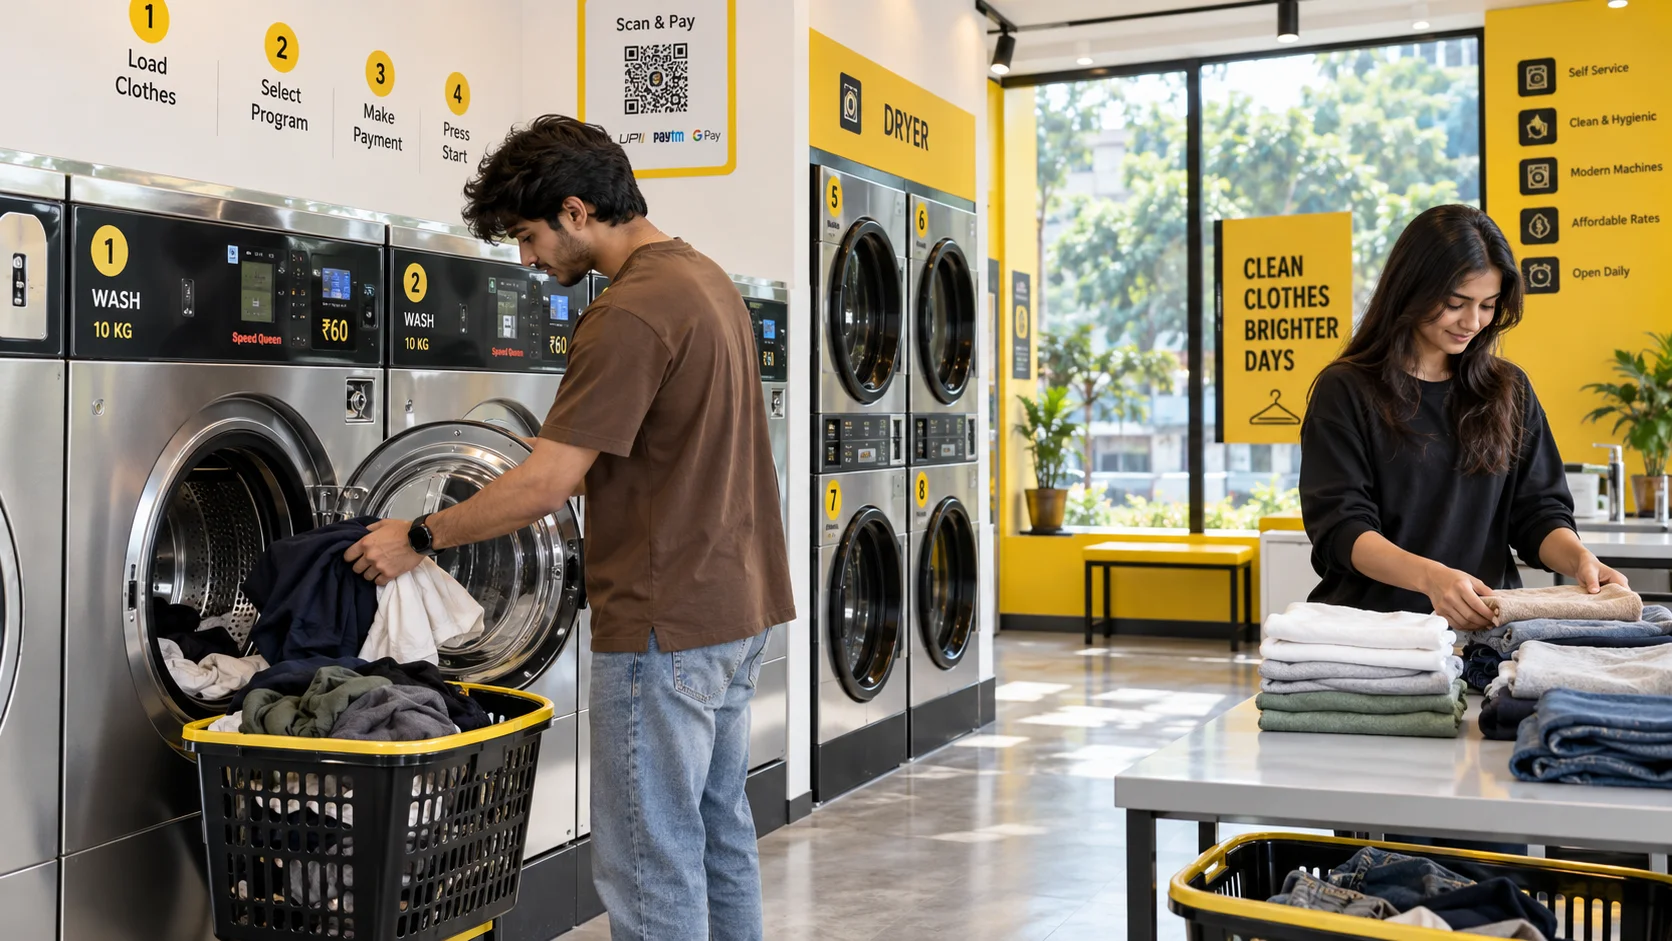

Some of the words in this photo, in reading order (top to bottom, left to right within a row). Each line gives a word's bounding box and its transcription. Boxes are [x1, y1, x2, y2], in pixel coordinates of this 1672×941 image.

[145, 4, 153, 28] 1
[616, 18, 650, 31] Scan
[654, 16, 665, 29] &
[669, 15, 695, 31] Pay
[276, 36, 287, 60] 2
[128, 49, 167, 75] Load
[1569, 65, 1588, 77] Self
[1591, 63, 1629, 76] Service
[376, 63, 385, 84] 3
[115, 76, 176, 105] Clothes
[261, 79, 301, 103] Select
[453, 84, 462, 103] 4
[251, 104, 309, 132] Program
[364, 103, 395, 125] Make
[1569, 116, 1598, 128] Clean
[1601, 115, 1609, 125] &
[1611, 111, 1657, 127] Hygienic
[443, 122, 470, 141] Press
[653, 130, 684, 143] paytm
[884, 103, 929, 151] DRYER
[353, 127, 402, 151] Payment
[442, 145, 468, 164] Start
[1570, 165, 1610, 177] Modern
[1613, 162, 1663, 175] Machines
[831, 186, 838, 208] 5
[919, 211, 925, 230] 6
[1572, 214, 1627, 228] Affordable
[1630, 213, 1660, 225] Rates
[104, 238, 113, 264] 1
[1244, 255, 1303, 279] CLEAN
[1572, 267, 1601, 281] Open
[1603, 265, 1630, 279] Daily
[411, 272, 420, 293] 2
[92, 289, 140, 310] WASH
[1244, 285, 1330, 310] CLOTHES
[94, 321, 110, 338] 10
[114, 322, 132, 339] KG
[322, 318, 348, 342] ₹60
[404, 312, 434, 328] WASH
[1245, 317, 1339, 340] BRIGHTER
[232, 332, 257, 346] Speed
[259, 333, 282, 345] Queen
[405, 337, 415, 350] 10
[417, 337, 429, 350] KG
[549, 336, 567, 354] ₹60
[1245, 349, 1294, 372] DAYS
[830, 489, 837, 511] 7
[919, 480, 925, 499] 8
